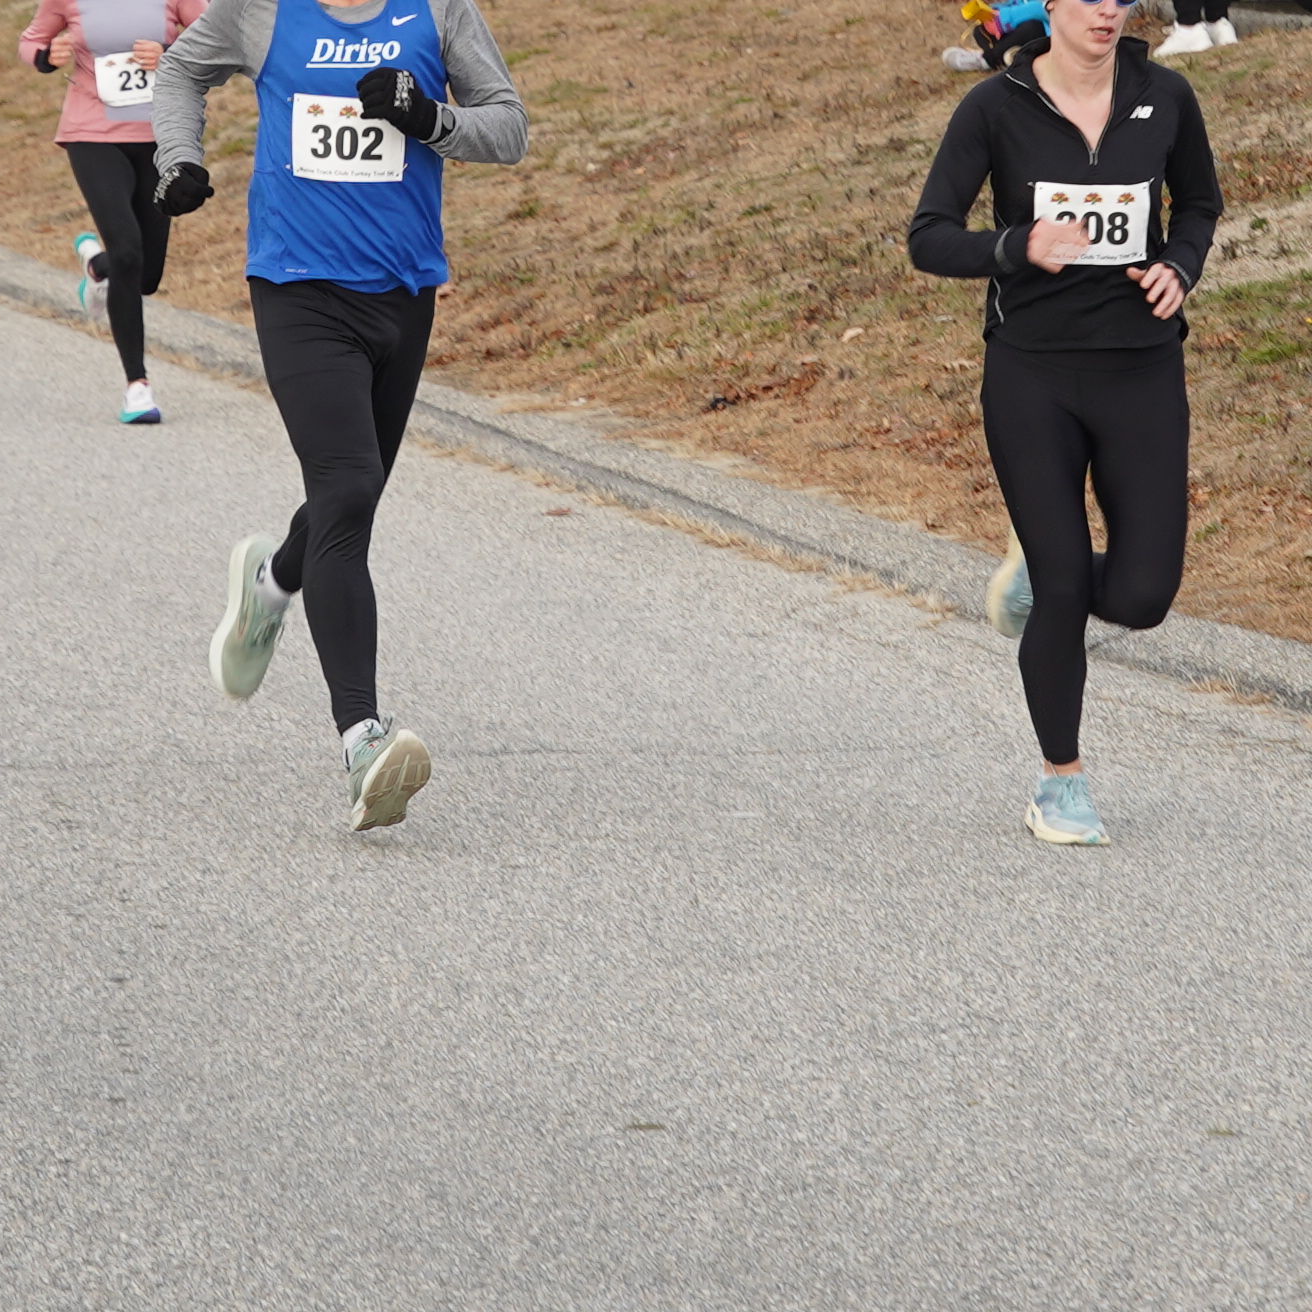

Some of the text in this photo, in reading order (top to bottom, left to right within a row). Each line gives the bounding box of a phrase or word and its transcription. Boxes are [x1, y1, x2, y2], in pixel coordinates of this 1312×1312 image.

[306, 38, 401, 68] Dirigo
[118, 69, 148, 92] 23
[310, 124, 384, 161] 302
